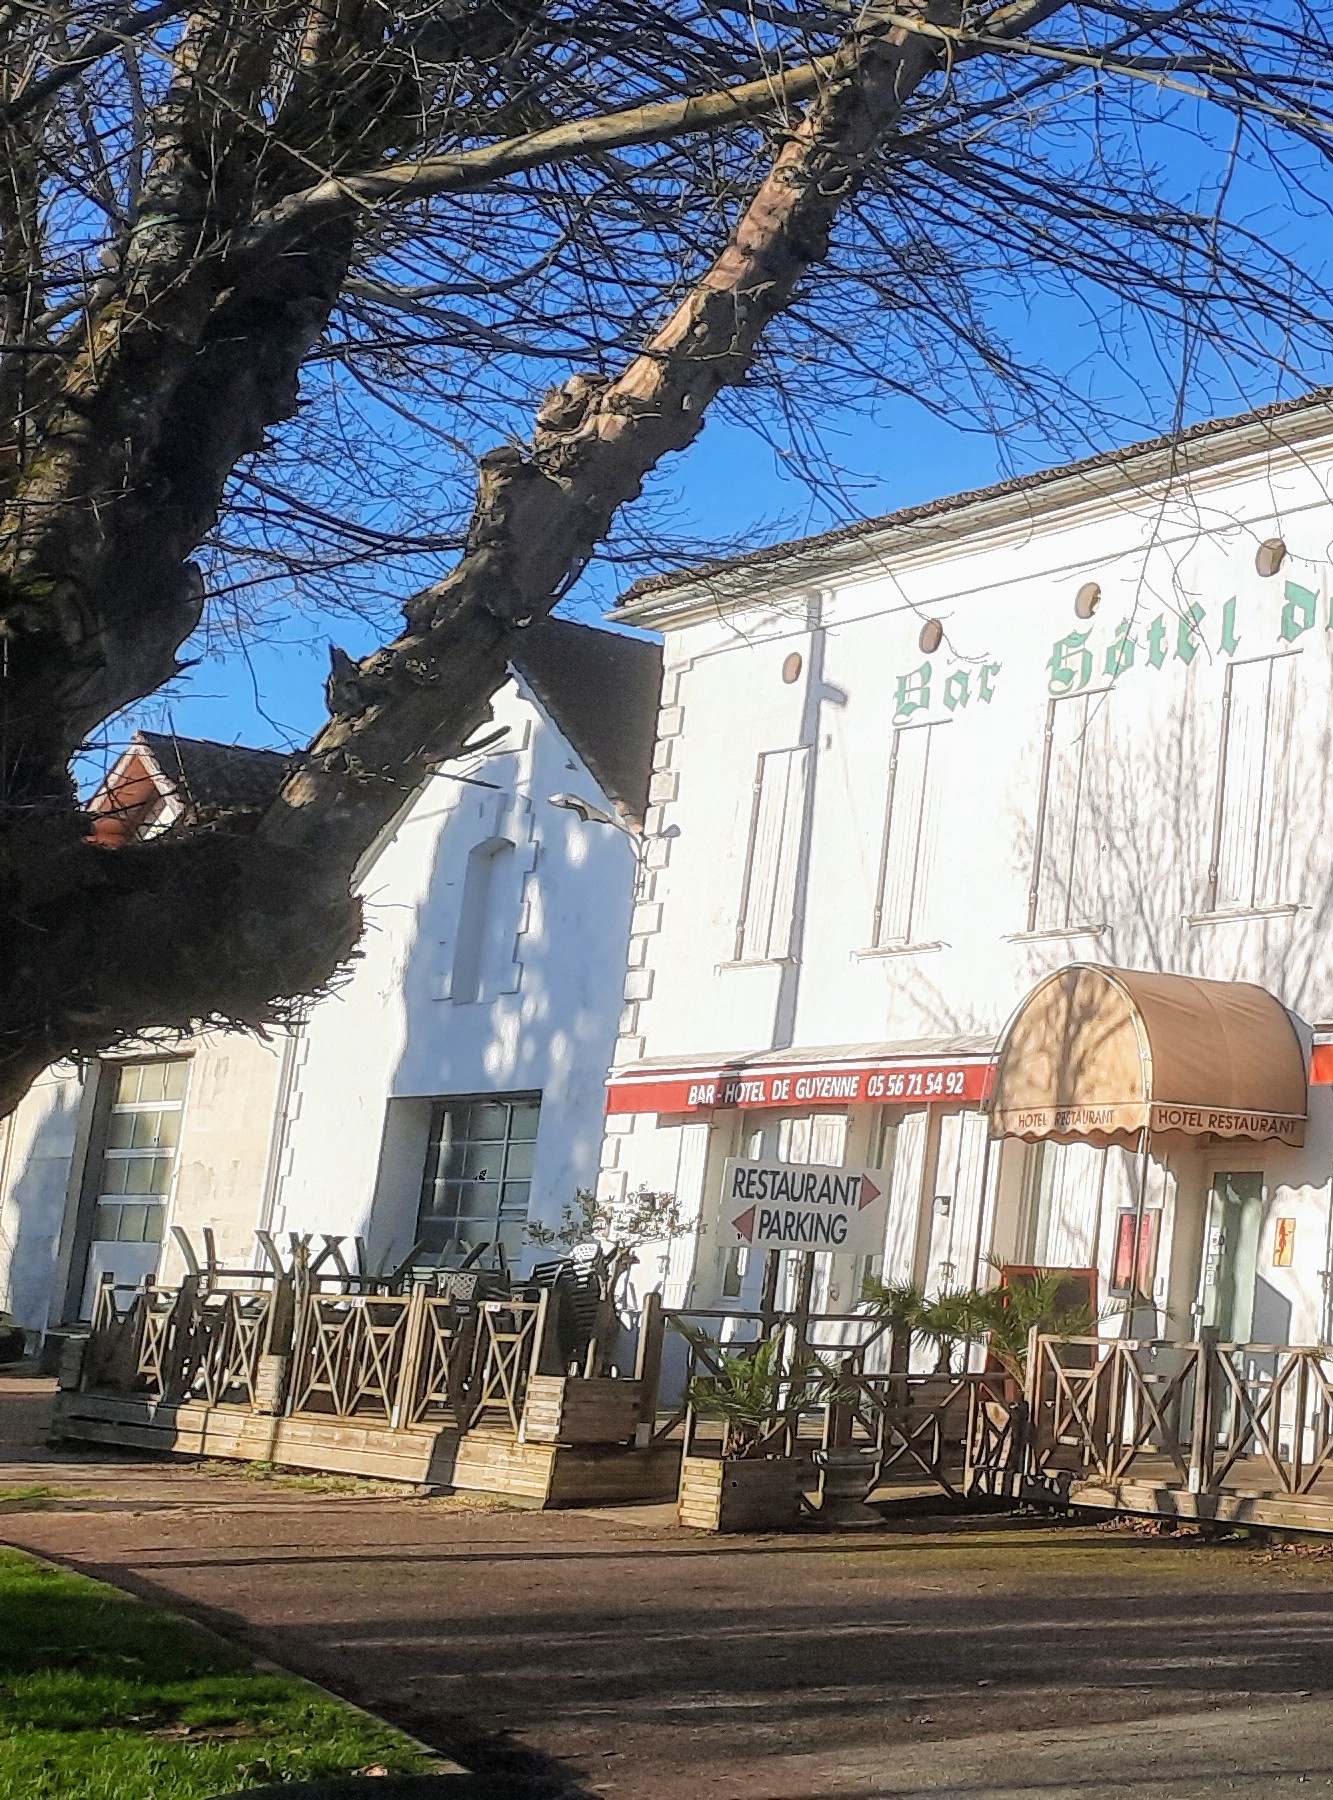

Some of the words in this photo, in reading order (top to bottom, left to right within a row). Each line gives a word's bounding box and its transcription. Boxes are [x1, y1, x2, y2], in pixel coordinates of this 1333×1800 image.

[893, 661, 1002, 727] Bar
[688, 1084, 715, 1105] BAR
[724, 1081, 766, 1103] HOTEL
[771, 1079, 790, 1100] DE
[795, 1075, 860, 1099] GUYENNE
[867, 1074, 883, 1096] 05
[886, 1073, 903, 1095] 56
[906, 1072, 922, 1095] 71
[924, 1072, 942, 1095] 54
[946, 1071, 964, 1094] 92
[1018, 1112, 1047, 1128] HOTEL
[1054, 1110, 1115, 1126] RESTAURANT
[1158, 1110, 1203, 1128] HOTEL
[1208, 1113, 1297, 1134] RESTAURANT
[732, 1167, 862, 1207] RESTAURANT
[758, 1209, 848, 1245] PARKING
